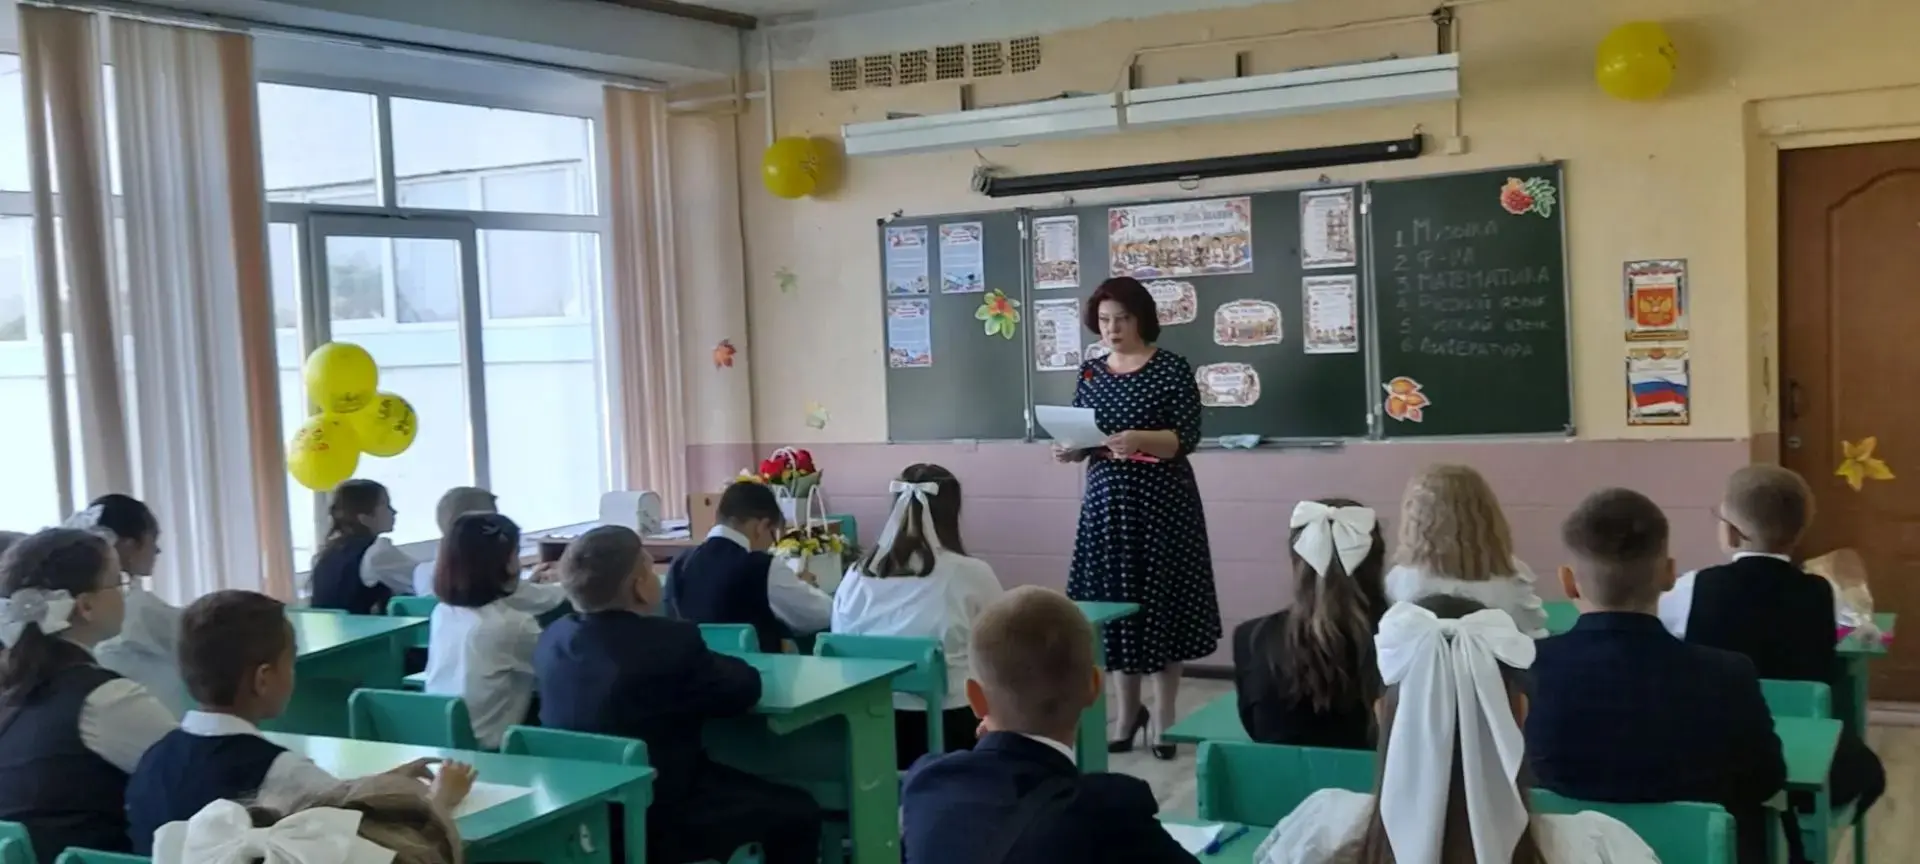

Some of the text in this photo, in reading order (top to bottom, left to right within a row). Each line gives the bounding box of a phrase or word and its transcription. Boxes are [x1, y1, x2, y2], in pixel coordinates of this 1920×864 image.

[1393, 253, 1410, 271] 2
[1396, 275, 1411, 295] 3
[1399, 317, 1412, 334] 5
[1401, 336, 1413, 352] 6
